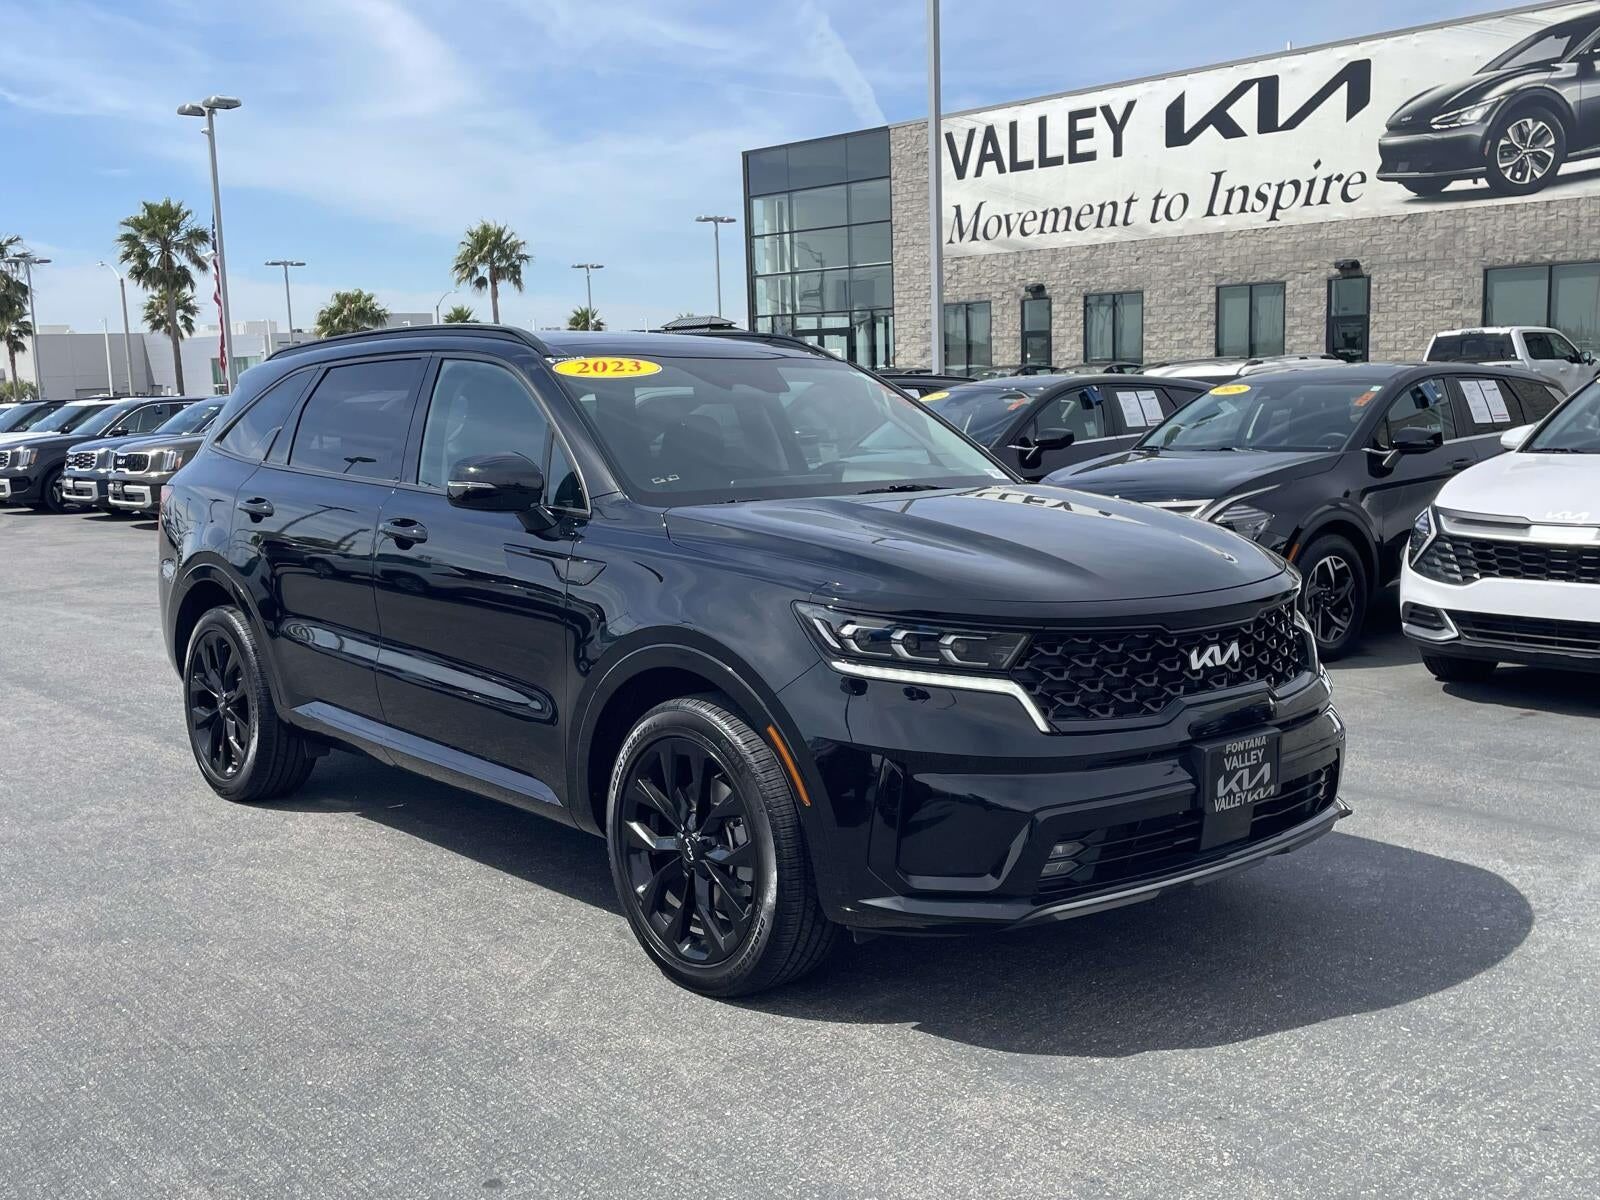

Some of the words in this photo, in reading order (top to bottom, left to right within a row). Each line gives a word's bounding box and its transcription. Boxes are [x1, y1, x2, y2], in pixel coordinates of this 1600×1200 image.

[944, 99, 1137, 180] VALLEY
[1165, 58, 1371, 148] KIA
[946, 192, 1140, 245] Movement
[1150, 188, 1190, 224] to
[1202, 158, 1367, 222] Inspire
[576, 360, 642, 374] 2023
[1190, 642, 1240, 670] KIA
[1226, 735, 1267, 754] FONTANA
[1224, 748, 1264, 771] VALLEY
[1217, 762, 1271, 798] KIA
[1215, 791, 1247, 812] VALLEY
[1247, 784, 1275, 803] KIA
